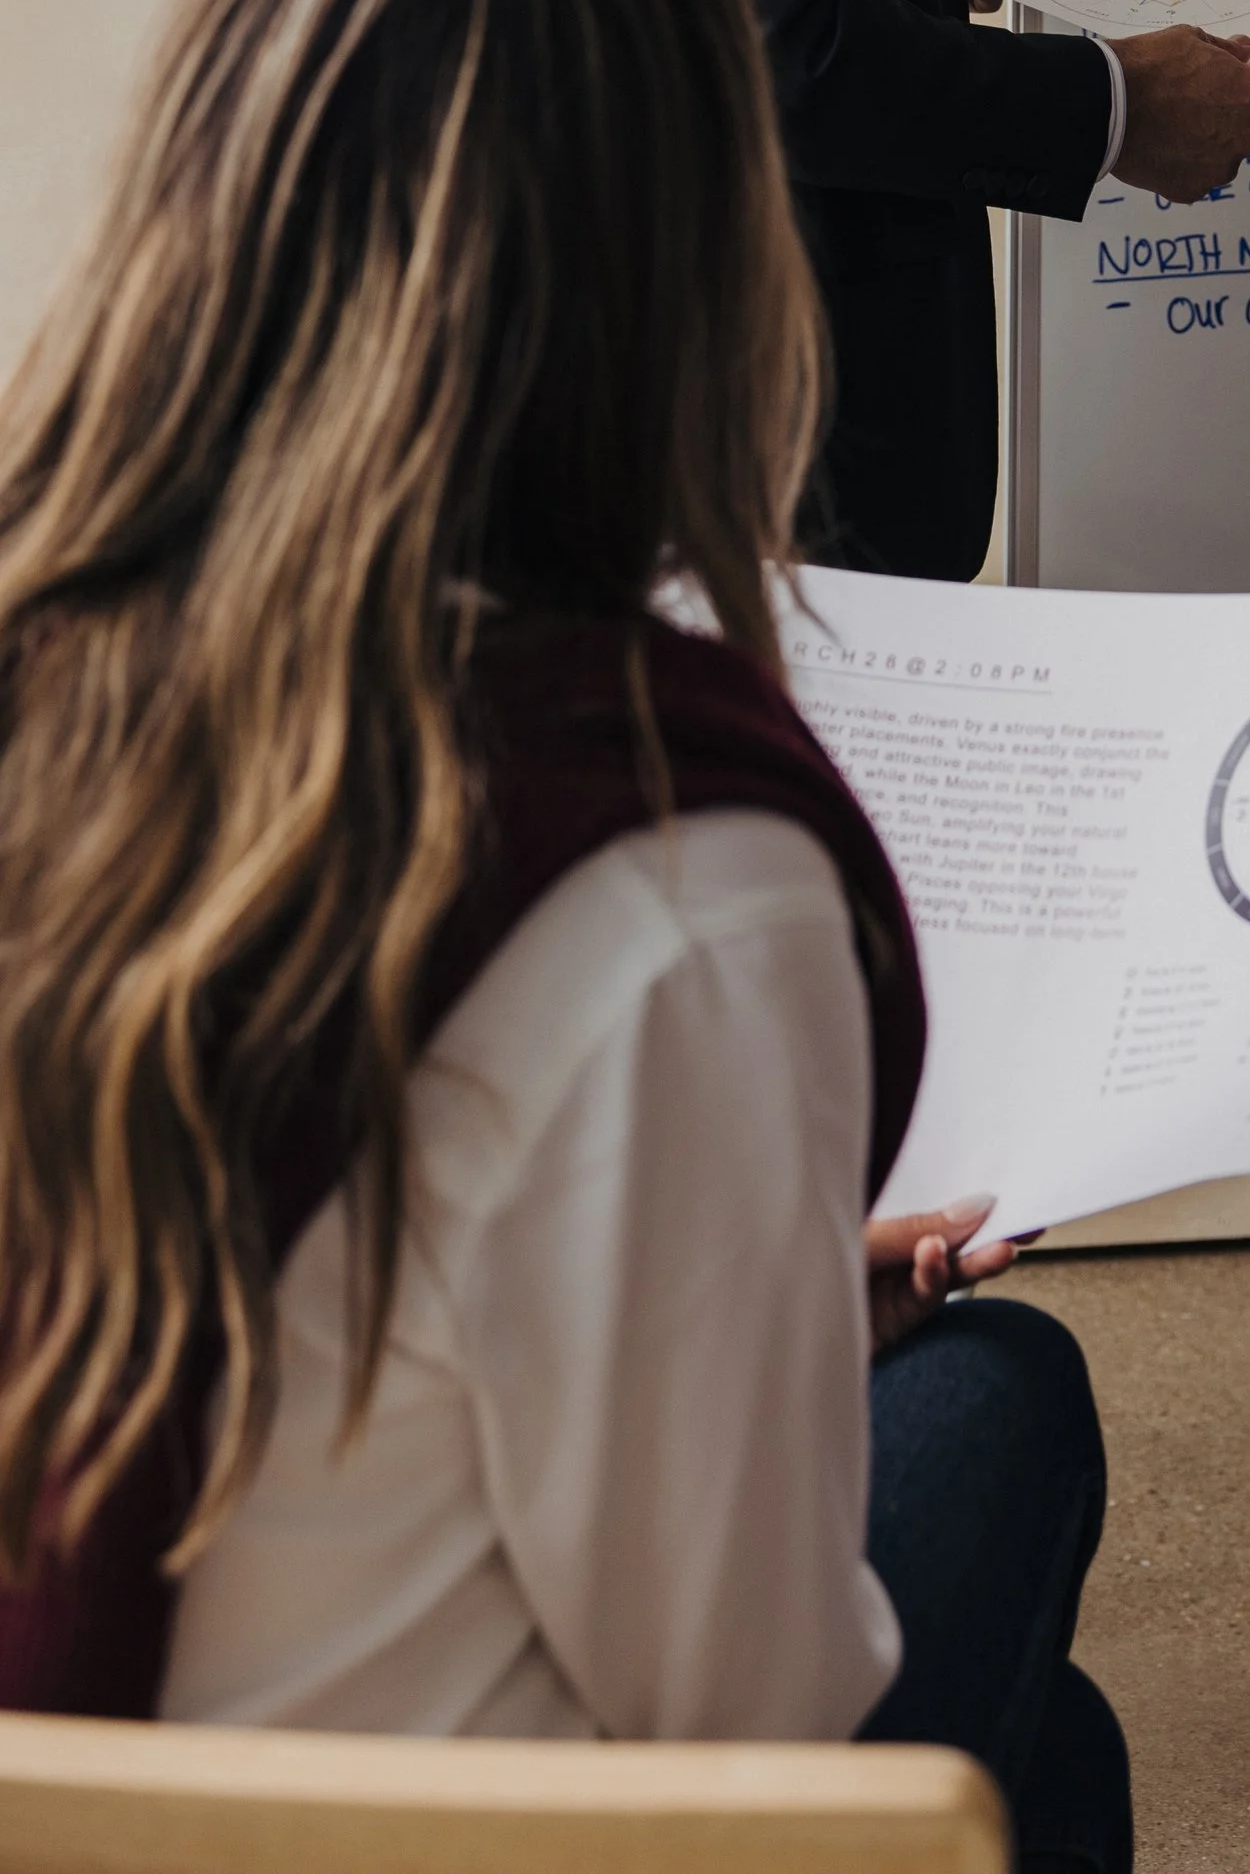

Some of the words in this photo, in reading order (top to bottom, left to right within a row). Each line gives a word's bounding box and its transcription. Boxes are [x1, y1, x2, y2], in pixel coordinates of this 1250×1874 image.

[1099, 232, 1222, 275] NORTH
[1167, 294, 1230, 334] Our
[845, 708, 901, 722] visible,
[908, 712, 958, 729] driven
[965, 717, 984, 735] by
[989, 722, 999, 733] a
[1005, 723, 1056, 739] strong
[1061, 724, 1087, 738] fire
[1091, 727, 1165, 740] presence
[958, 737, 1005, 752] Venus
[1012, 742, 1069, 759] exactly
[1073, 746, 1140, 761] conjunct
[1145, 747, 1170, 760] the
[849, 747, 879, 758] and
[885, 750, 962, 768] attractive
[967, 759, 1015, 774] public
[1080, 764, 1142, 784] drawing
[865, 767, 907, 782] while
[913, 772, 938, 786] the
[945, 776, 989, 790] Moon
[995, 780, 1010, 792] in
[1014, 780, 1045, 795] Leo
[1070, 783, 1095, 798] the
[897, 793, 927, 806] and
[1036, 801, 1069, 817] This
[943, 817, 1025, 837] amplifying
[1031, 824, 1066, 838] your
[926, 833, 969, 850] leans
[976, 839, 1018, 853] more
[1022, 842, 1078, 857] toward
[900, 854, 933, 866] with
[938, 855, 995, 872] Jupiter
[1001, 860, 1015, 873] in
[1020, 862, 1046, 875] the
[907, 870, 962, 889] Pisces
[967, 880, 1041, 899] opposing
[981, 898, 1013, 913] This
